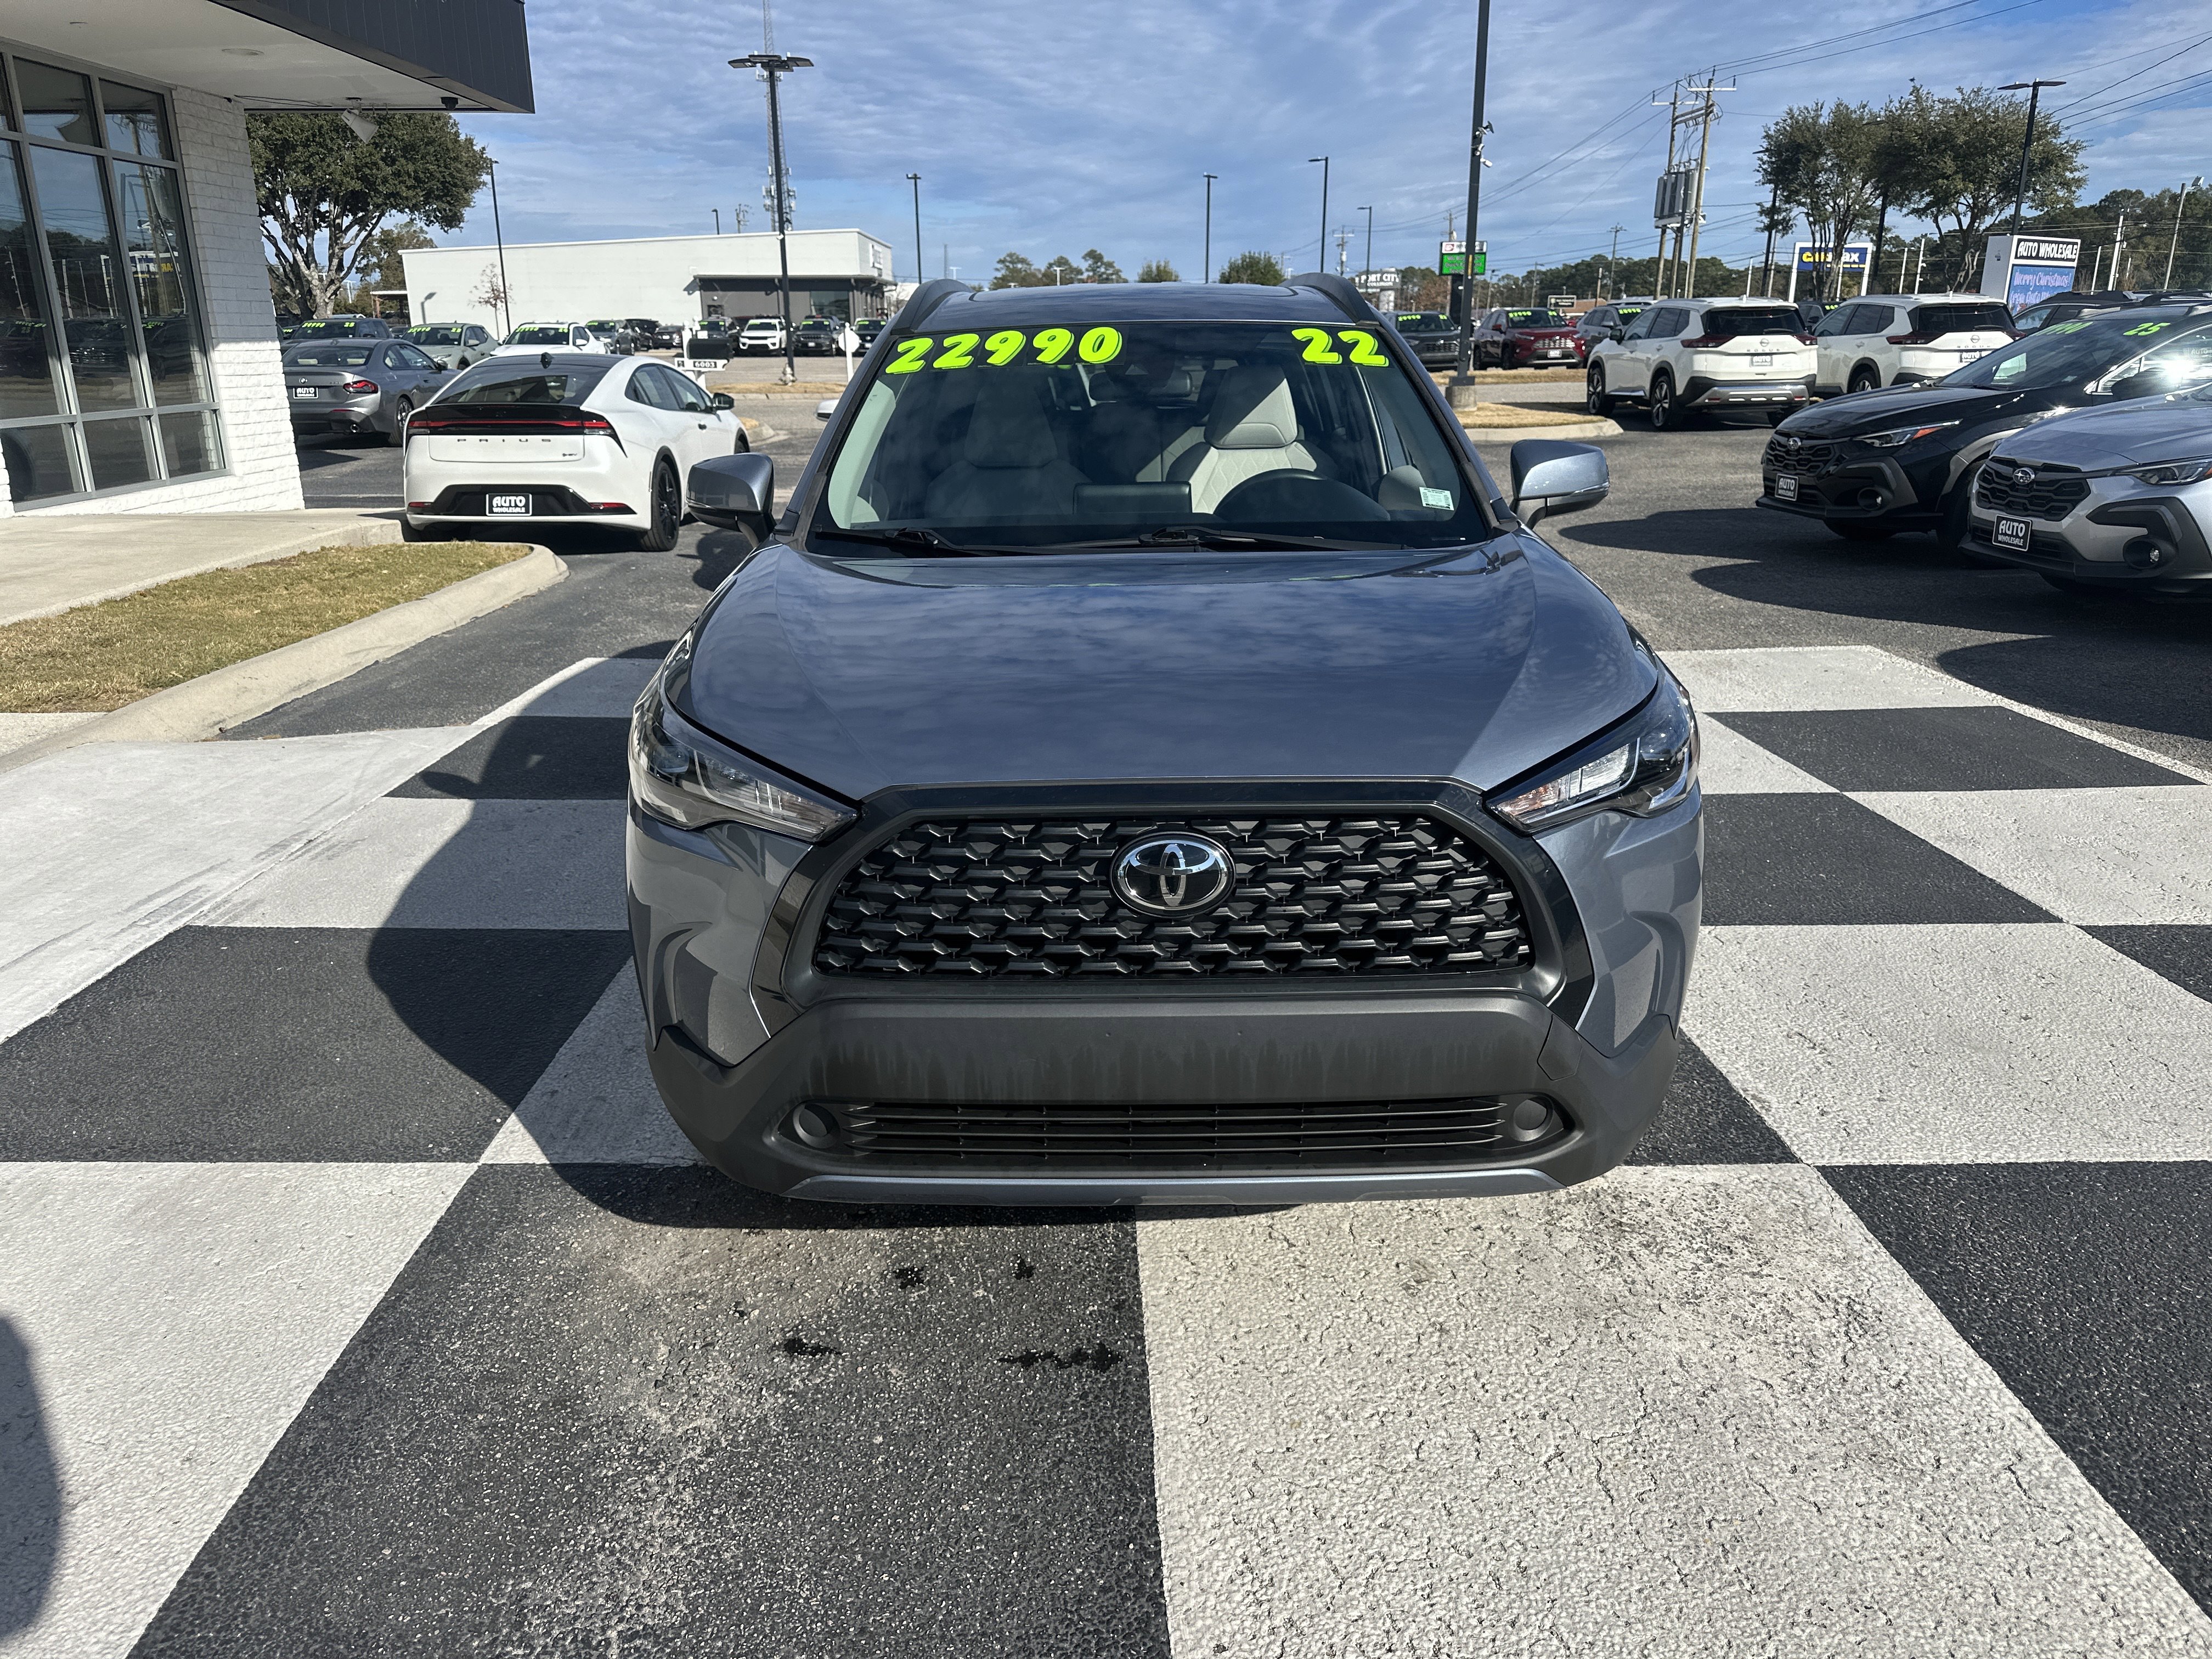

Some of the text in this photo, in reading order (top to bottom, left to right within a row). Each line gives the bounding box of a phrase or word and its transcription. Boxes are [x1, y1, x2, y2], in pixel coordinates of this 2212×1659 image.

[2018, 241, 2078, 259] AUTO WHOLESALE
[2123, 323, 2171, 336] 25
[885, 326, 1390, 375] 22990 22
[1779, 478, 1795, 490] AUTO
[493, 496, 526, 507] AUTO
[1999, 520, 2025, 537] AUTO
[1998, 534, 2024, 546] WHOLESALE
